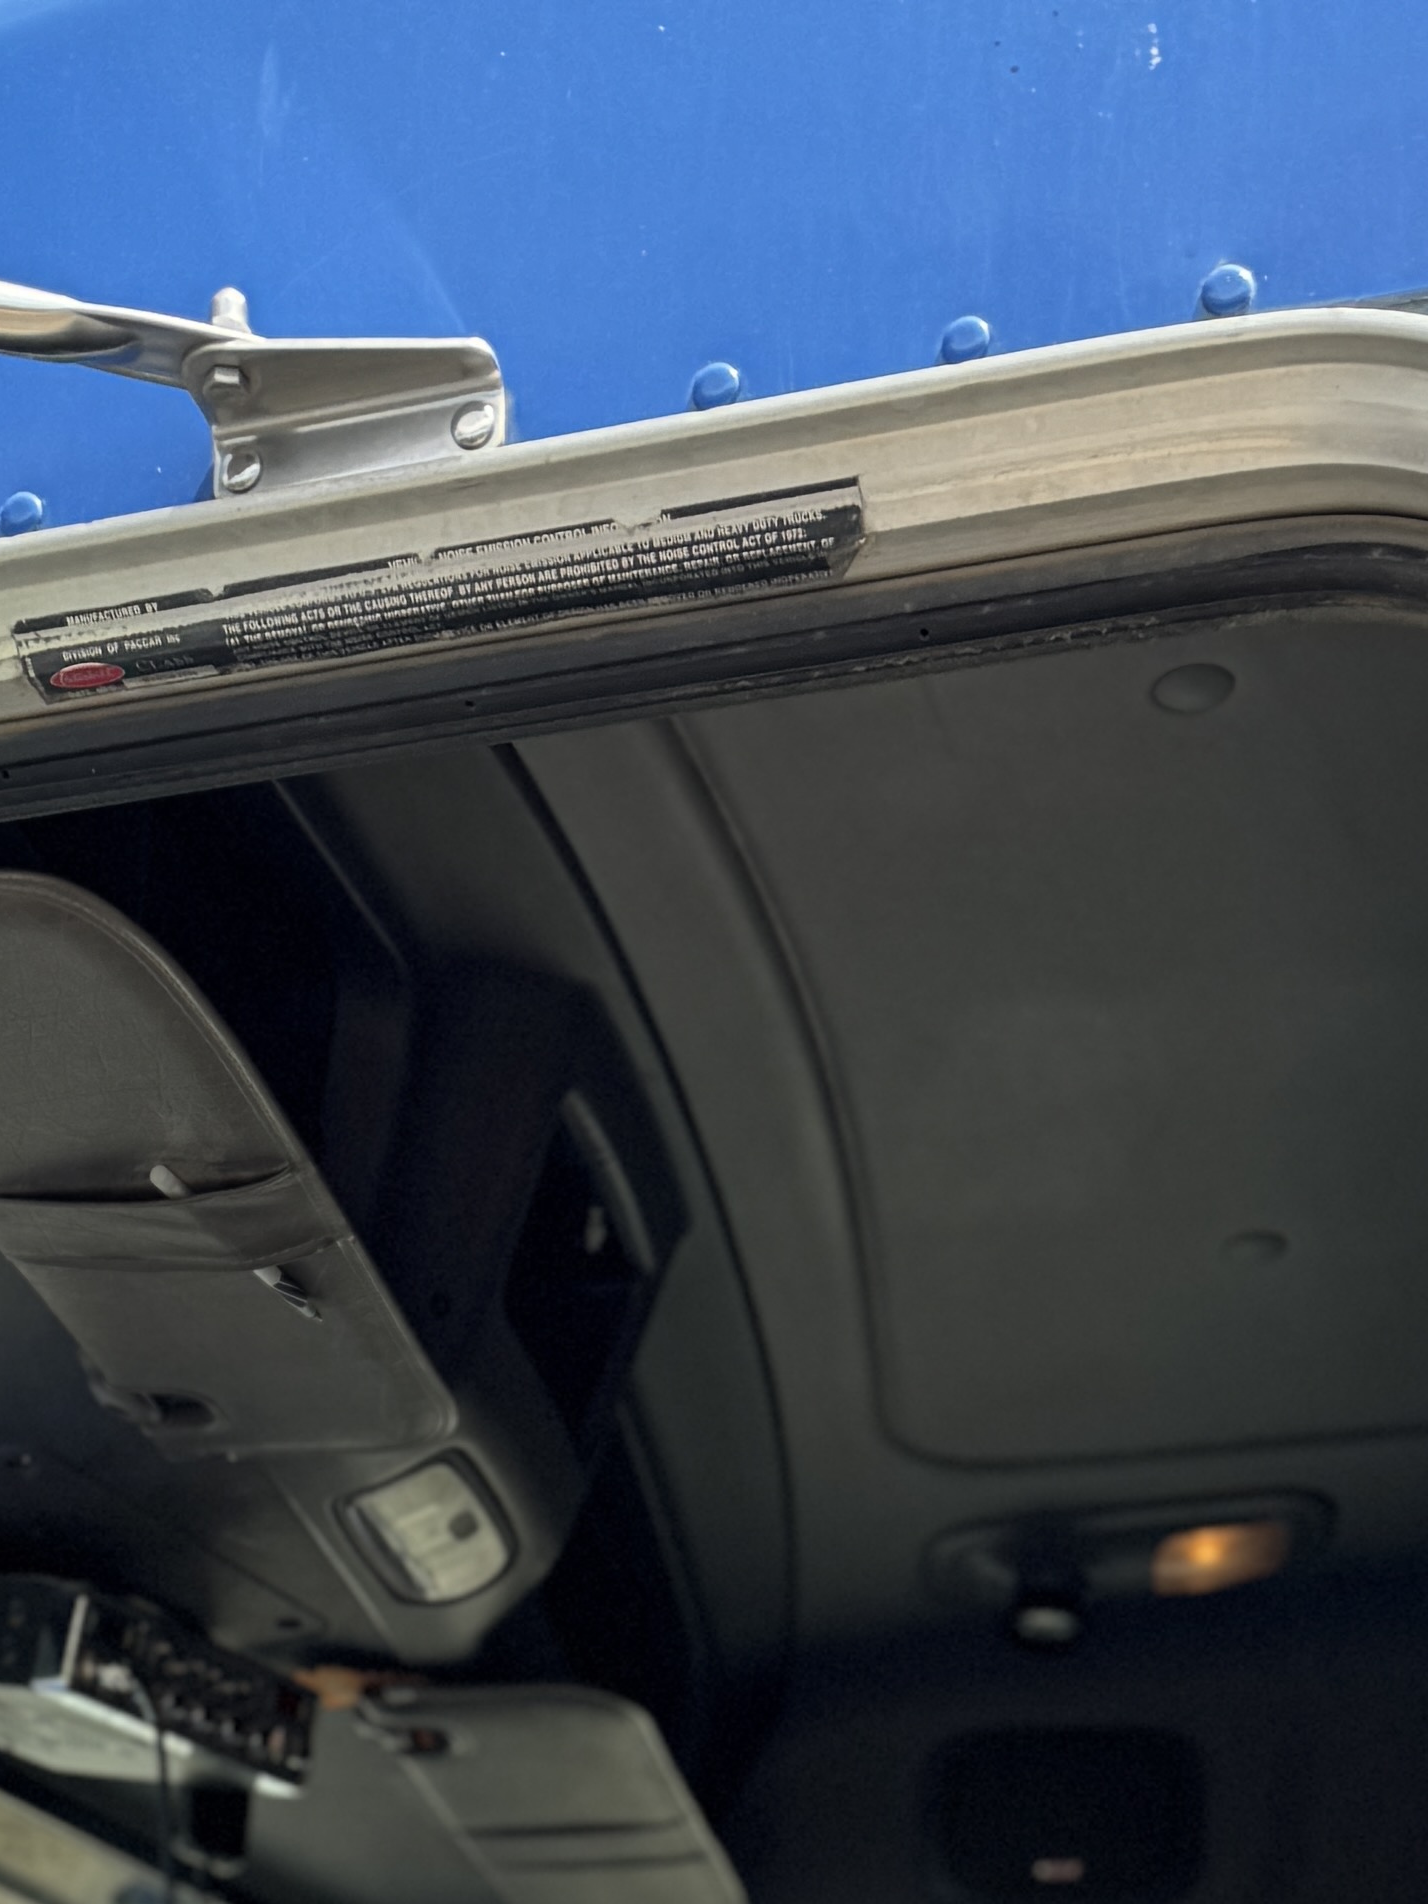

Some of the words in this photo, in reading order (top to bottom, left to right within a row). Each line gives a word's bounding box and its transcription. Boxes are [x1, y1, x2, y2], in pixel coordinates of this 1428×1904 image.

[752, 517, 778, 531] DUTY
[781, 508, 826, 526] TRUCKS.
[222, 621, 240, 635] THE
[242, 611, 298, 631] FOLLOWING
[301, 607, 325, 622] ACTS
[342, 601, 362, 615] THE
[364, 593, 406, 611] CAUSING
[408, 586, 452, 604] THEREOF
[474, 579, 492, 593] ANY
[495, 572, 536, 589] PERSON
[538, 569, 558, 582] ARE
[560, 558, 618, 579] PROHIBITED
[636, 552, 656, 566] THE
[658, 547, 690, 563] NOISE
[692, 538, 740, 557] CONTROL
[742, 535, 761, 549] ACT
[66, 604, 140, 626] MANUFACTURED
[62, 644, 102, 661] DIVISION
